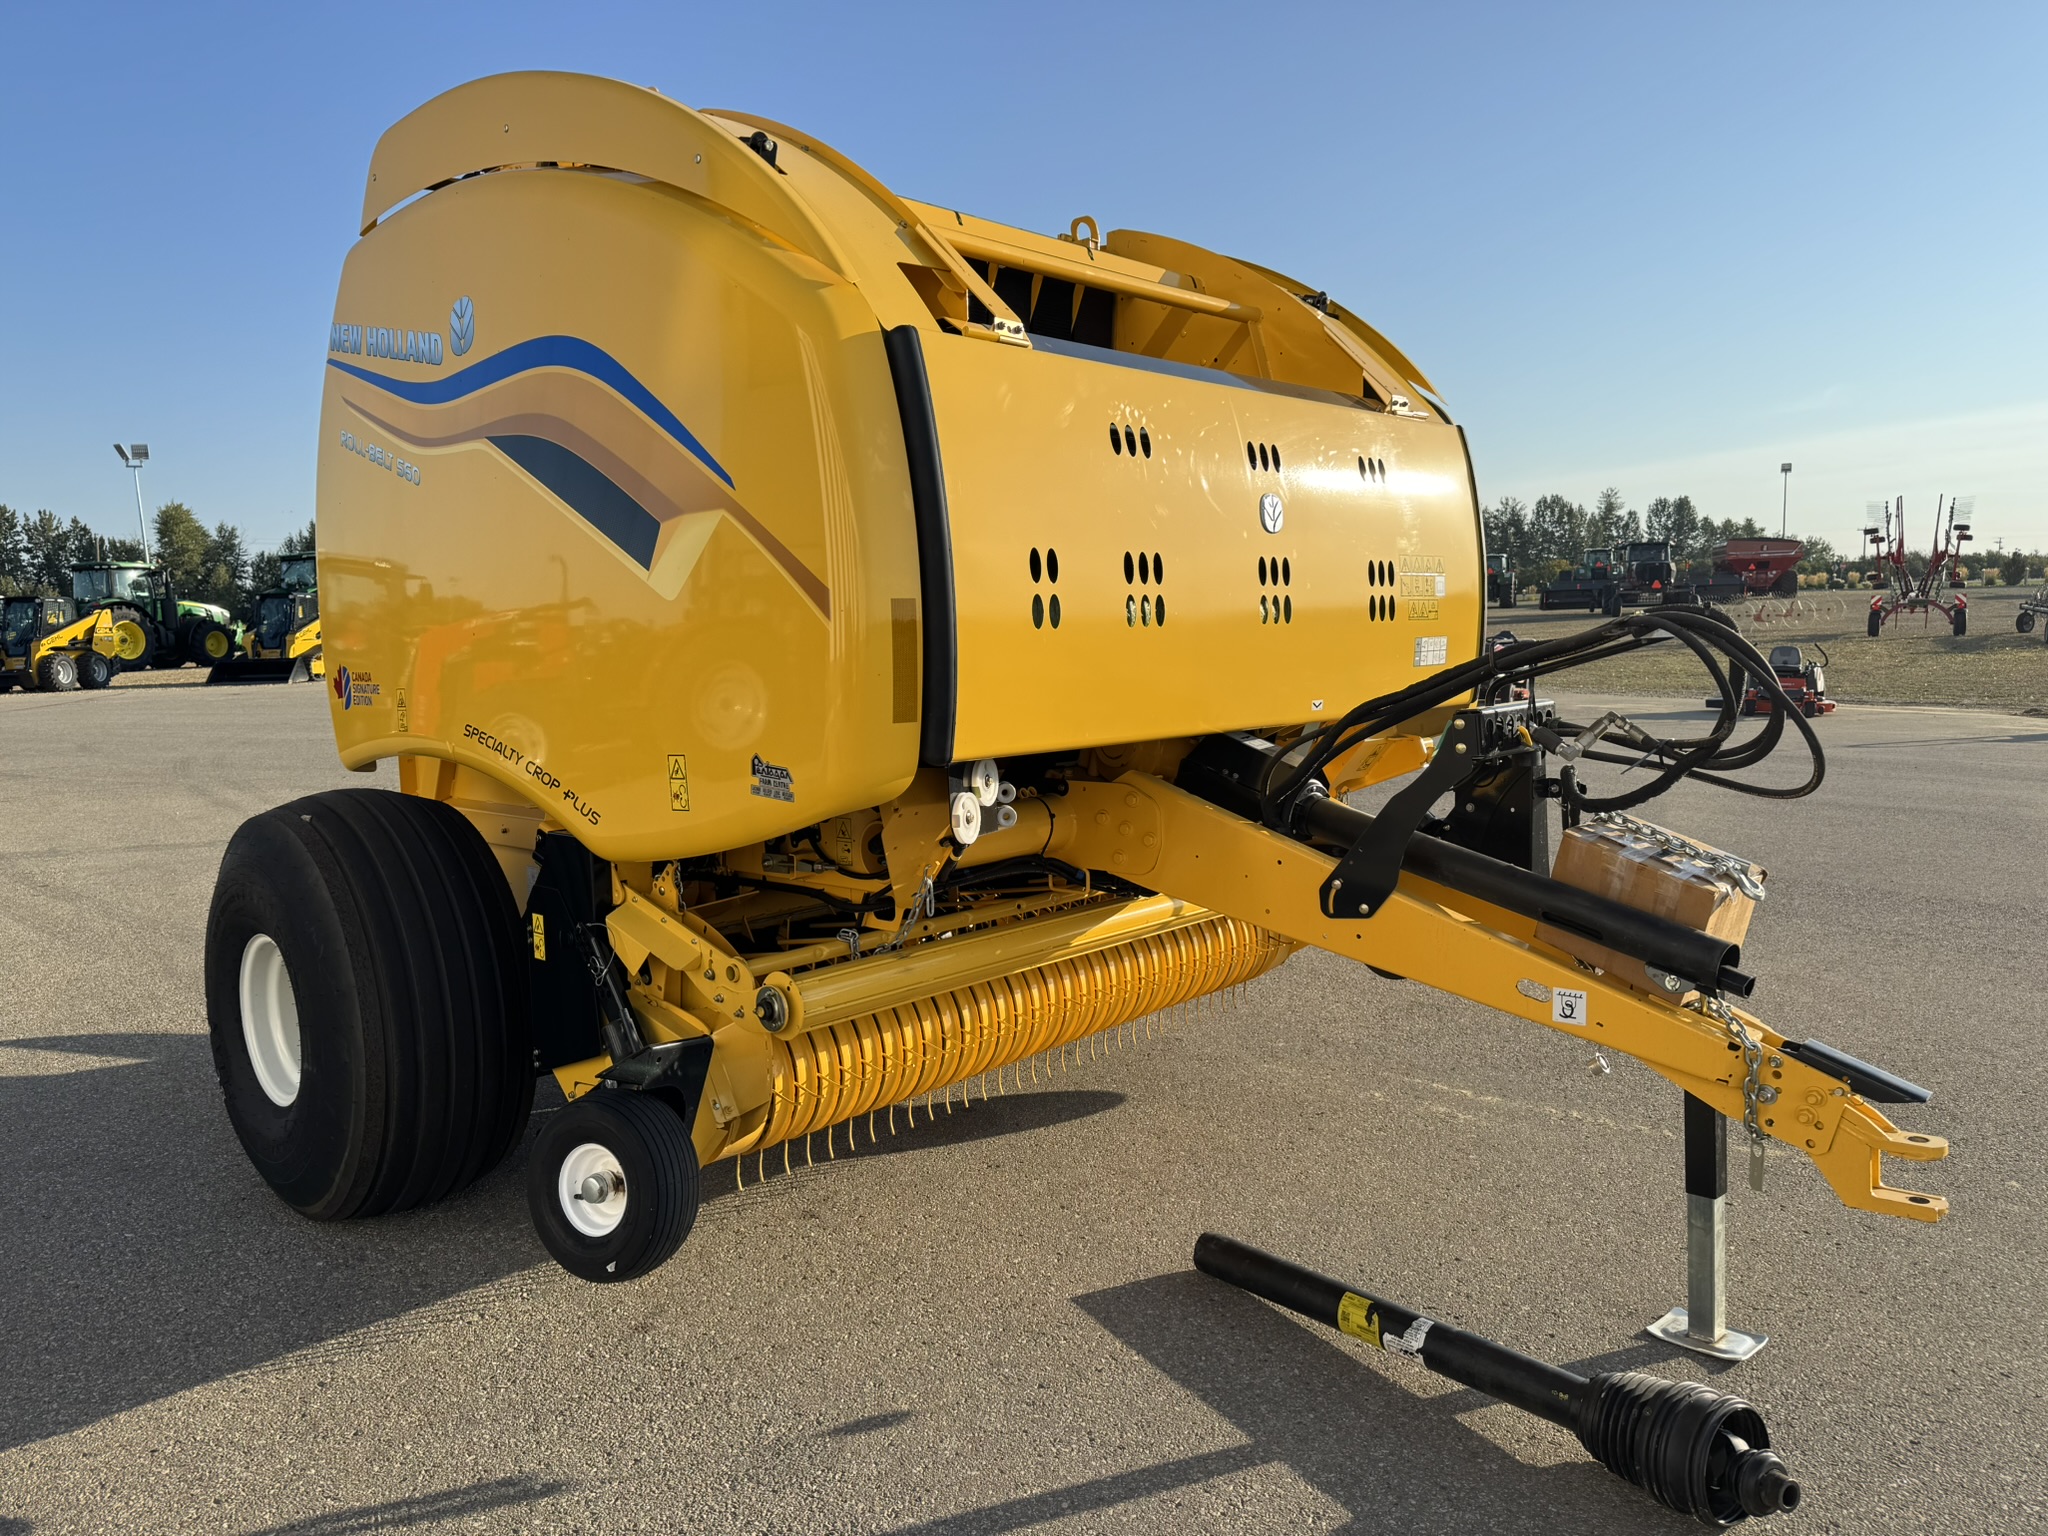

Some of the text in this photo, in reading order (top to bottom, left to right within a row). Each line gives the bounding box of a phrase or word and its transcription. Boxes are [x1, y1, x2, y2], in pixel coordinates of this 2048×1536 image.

[330, 322, 443, 366] NEW HOLLAND
[340, 430, 421, 486] ROLL-BELT 560
[46, 633, 64, 646] GEHL
[351, 671, 372, 682] CANADA
[352, 683, 380, 695] SIGNATURE
[353, 695, 373, 706] EDITION
[463, 723, 524, 765] SPECIALTY
[525, 760, 561, 789] CROP
